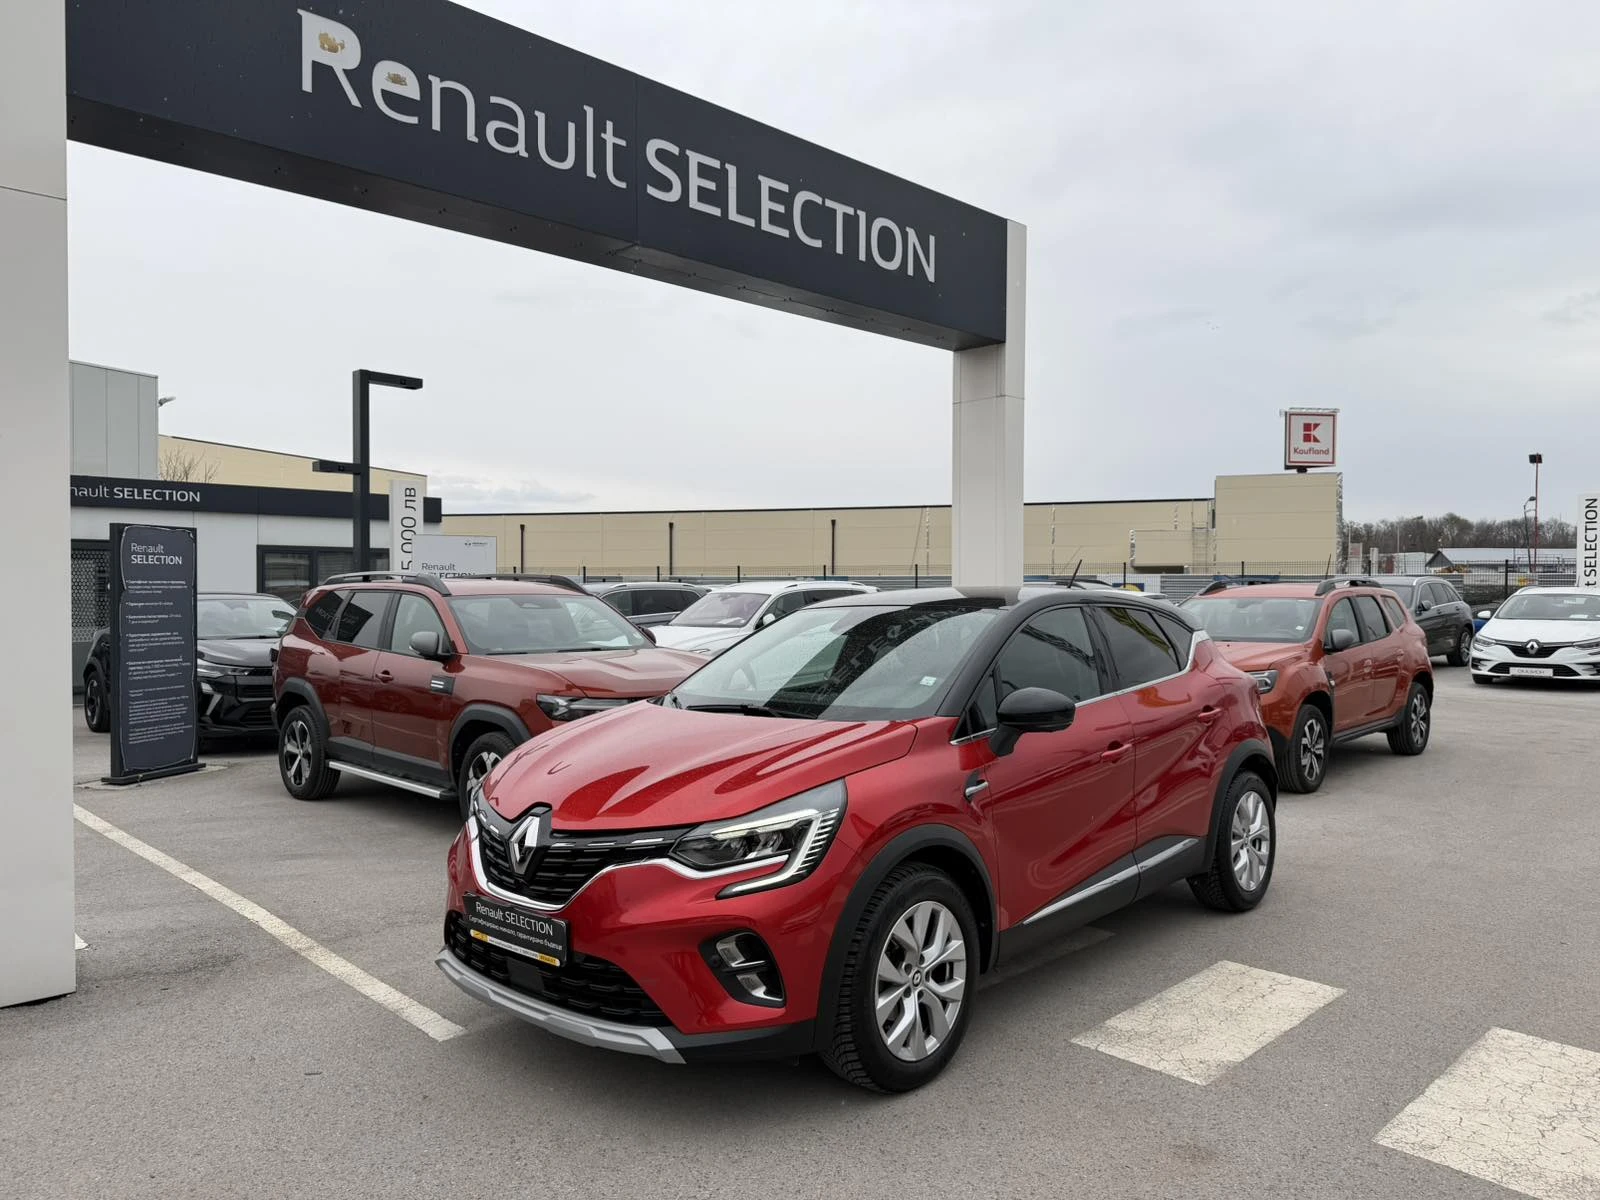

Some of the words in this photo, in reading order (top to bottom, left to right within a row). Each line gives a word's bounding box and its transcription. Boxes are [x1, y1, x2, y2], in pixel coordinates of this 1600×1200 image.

[297, 8, 627, 190] Renault
[645, 137, 937, 284] SELECTION
[113, 486, 201, 503] SELECTION
[1583, 498, 1598, 577] SELECTION
[130, 542, 165, 554] Renault
[130, 554, 183, 565] SELECTION
[421, 562, 456, 571] Renault
[475, 902, 504, 921] Renault
[505, 911, 553, 936] SELECTION
